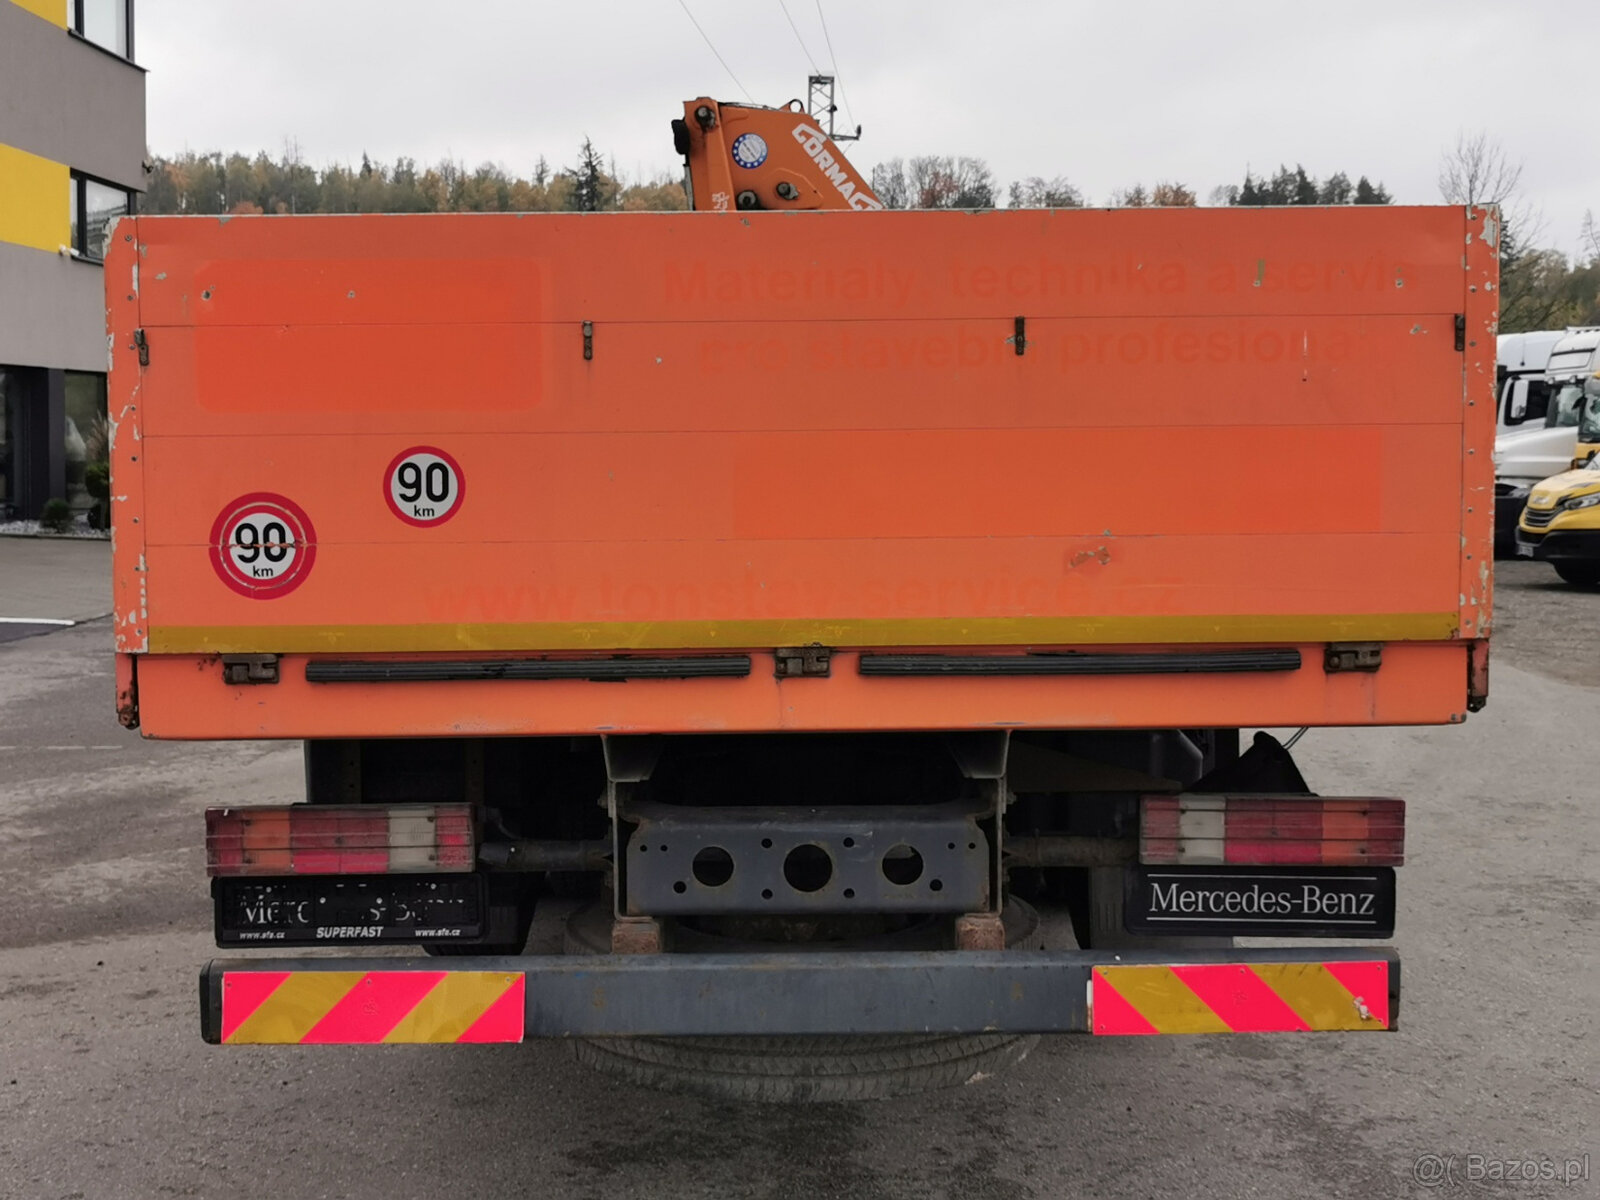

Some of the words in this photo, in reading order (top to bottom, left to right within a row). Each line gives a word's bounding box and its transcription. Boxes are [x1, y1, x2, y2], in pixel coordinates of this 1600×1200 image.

[398, 462, 450, 503] 90
[414, 504, 435, 518] km
[235, 521, 287, 563] 90
[253, 565, 274, 577] km
[1149, 882, 1376, 915] Mercedes-Benz
[316, 926, 383, 939] SUPERFAST
